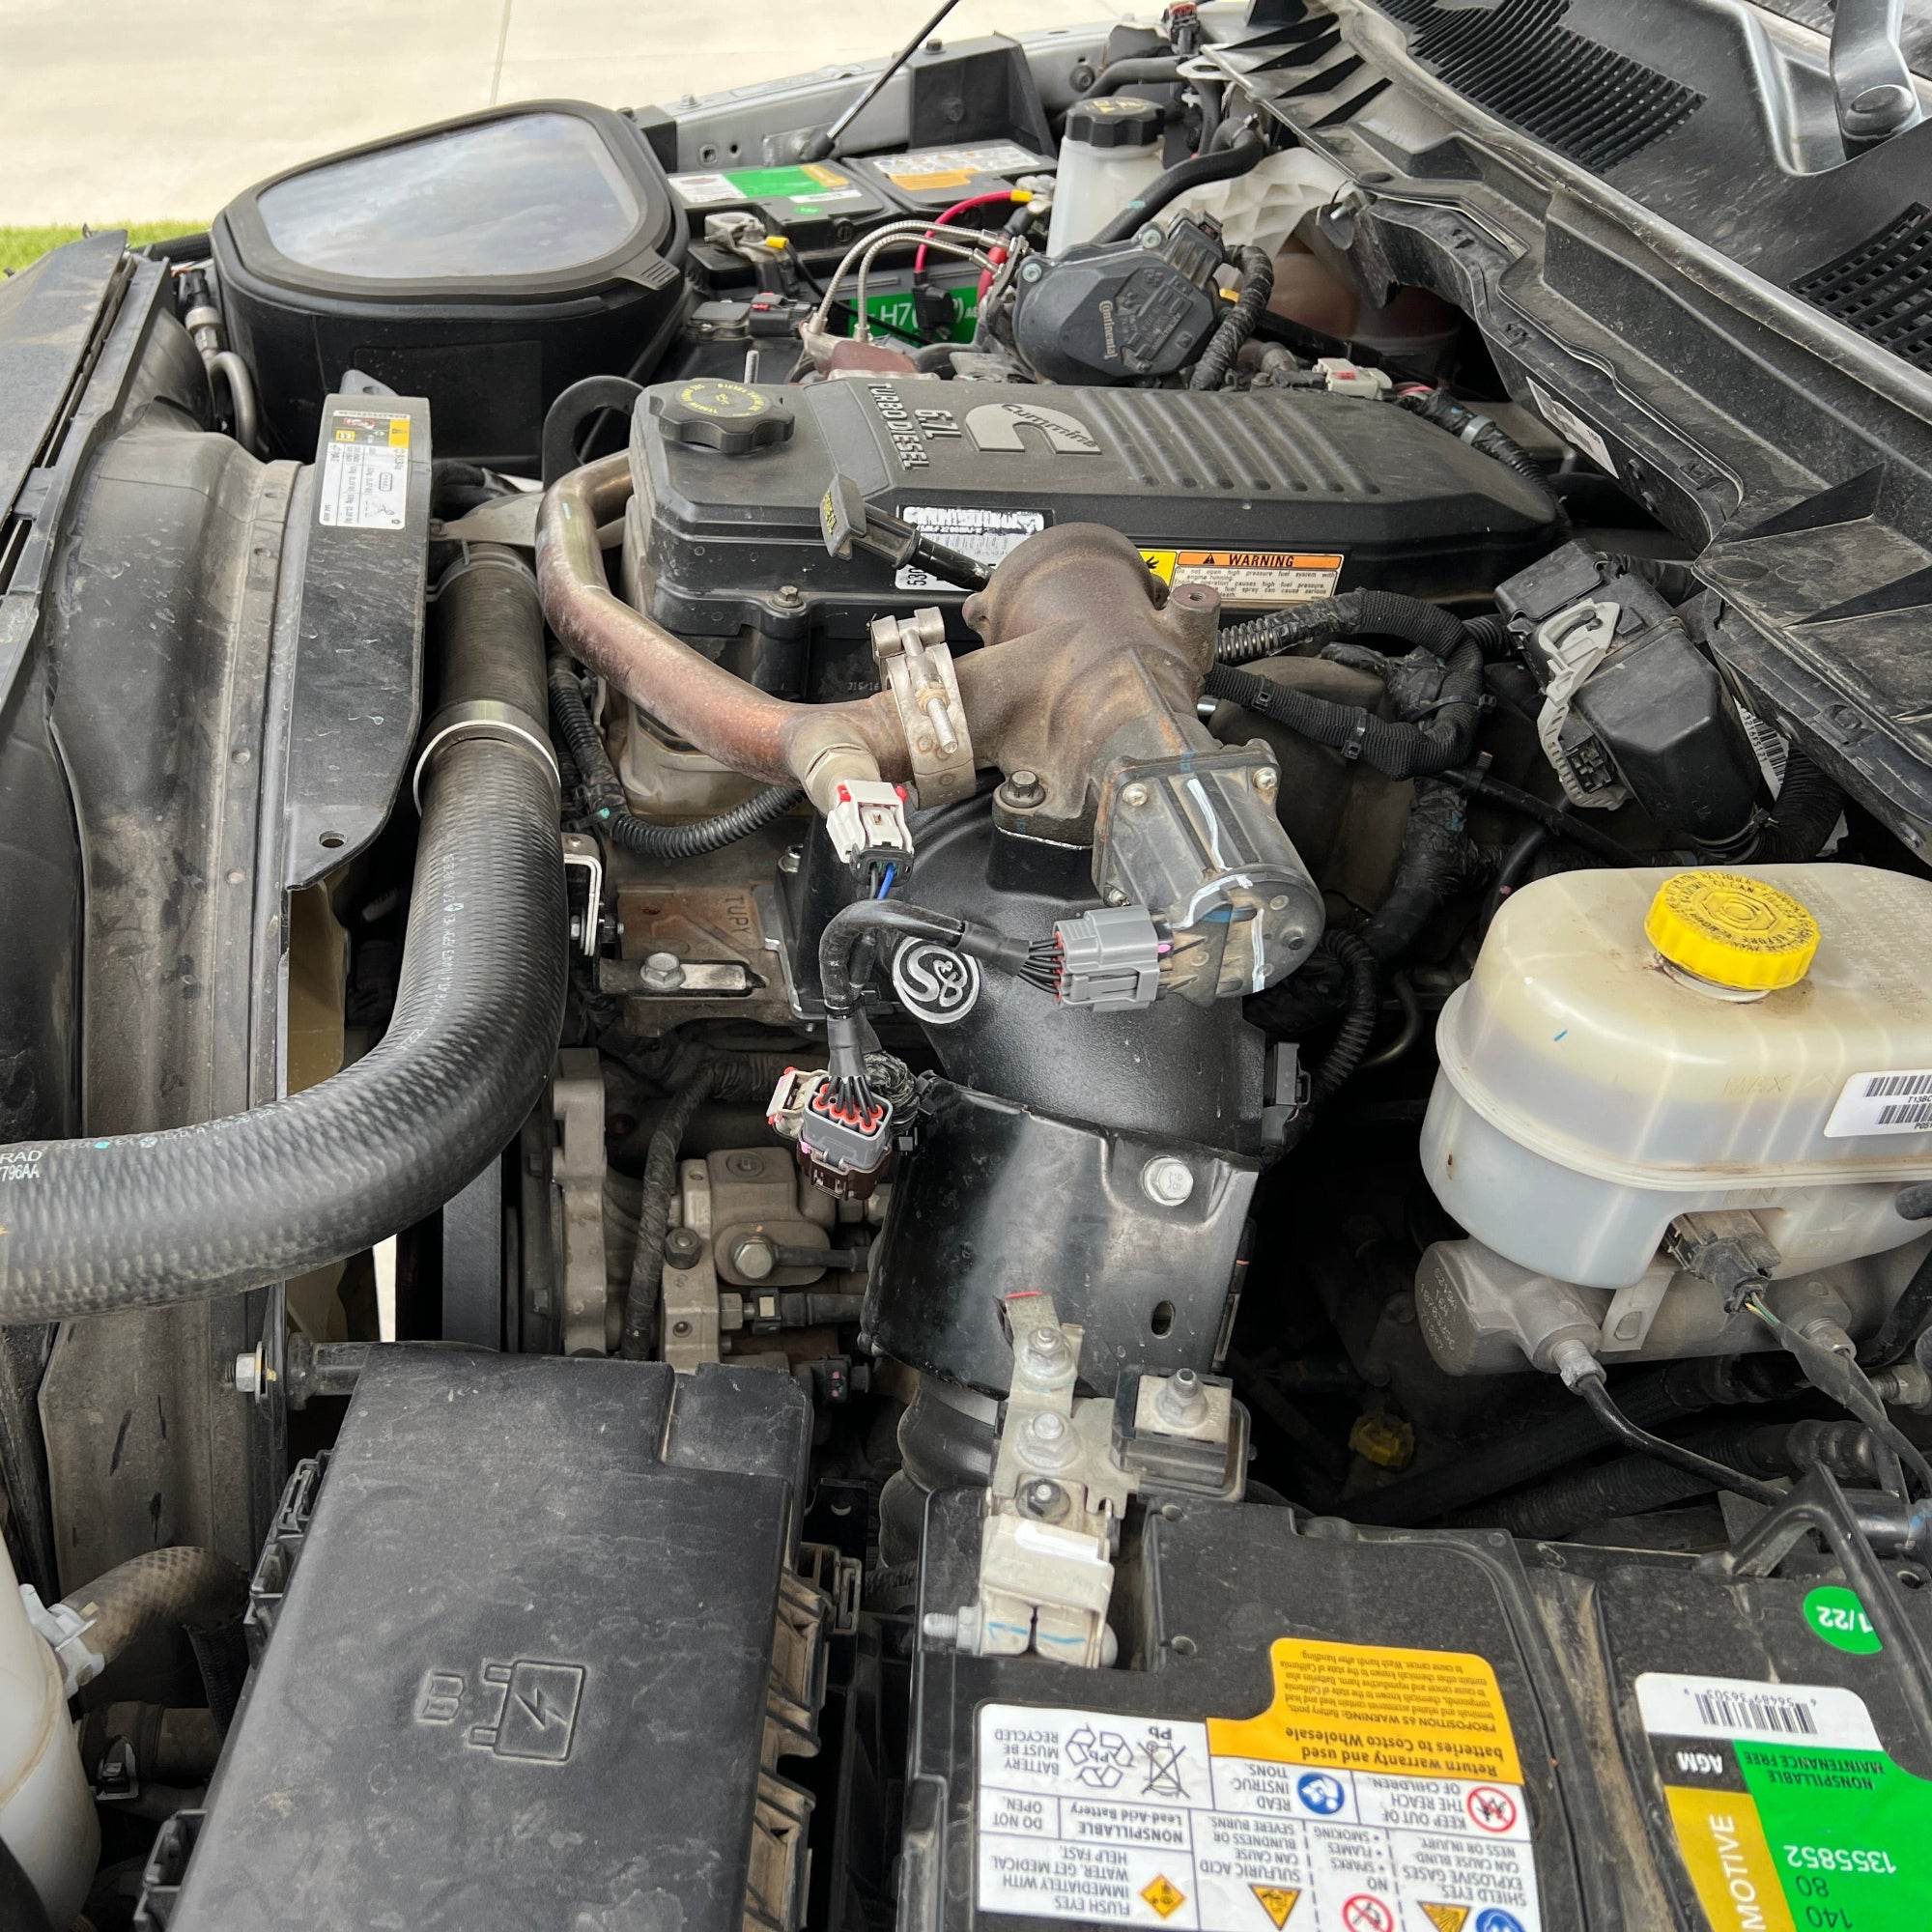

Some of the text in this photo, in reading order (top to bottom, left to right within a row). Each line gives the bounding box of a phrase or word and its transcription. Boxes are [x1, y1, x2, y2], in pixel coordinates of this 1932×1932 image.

[1098, 299, 1119, 360] Continental
[867, 383, 929, 471] TURBO DIESEL
[914, 409, 962, 440] 6.7L
[1002, 403, 1098, 448] Cummins
[1229, 554, 1294, 567] WARNING
[724, 896, 752, 934] TUPY
[0, 1150, 43, 1164] RAD
[1279, 1660, 1316, 1672] California
[1300, 1650, 1463, 1674] to cause cancer. Wash hands after handling.
[1327, 1665, 1345, 1675] state
[1347, 1667, 1359, 1677] the
[1370, 1669, 1396, 1681] known
[1397, 1672, 1435, 1683] chemicals
[1437, 1675, 1457, 1685] other
[1459, 1677, 1488, 1686] contain
[1285, 1671, 1486, 1697] to cause cancer and reproductive harm. Batteries also
[1285, 1683, 1491, 1708] compounds, chemicals known to the state of California
[1285, 1694, 1495, 1719] terminals and related accessories contain lead and lead
[1312, 1706, 1339, 1718] Battery
[1342, 1710, 1400, 1724] WARNING:
[1403, 1716, 1416, 1725] 65
[1418, 1718, 1496, 1733] PROPOSITION
[993, 1727, 1059, 1744] RECYCLED
[1148, 1726, 1172, 1741] Pb
[1003, 1744, 1059, 1759] MUST BE
[1285, 1727, 1504, 1762] batteries to Costco Wholesale
[1089, 1750, 1109, 1764] Pb
[1300, 1747, 1497, 1777] Return warranty and used
[1676, 1751, 1723, 1775] AGM
[1743, 1750, 1884, 1775] MAINTENANCE FREE
[1004, 1758, 1060, 1776] BATTERY
[1244, 1763, 1289, 1778] TIONS.
[1229, 1777, 1290, 1795] INSTRUC-
[1367, 1777, 1461, 1795] OF CHILDREN.
[1767, 1770, 1874, 1790] NONSPILLABLE
[1003, 1797, 1043, 1814] OPEN.
[1256, 1795, 1291, 1811] READ
[1391, 1793, 1464, 1812] THE REACH
[991, 1812, 1043, 1830] DO NOT
[1070, 1803, 1182, 1826] Lead-Acid Battery
[1381, 1808, 1466, 1831] KEEP OUT OF
[1078, 1821, 1182, 1843] NONSPILLABLE
[1208, 1815, 1294, 1835] SEVERE BURNS.
[1313, 1826, 1370, 1842] SMOKING
[1213, 1832, 1296, 1851] BLINDNESS OR
[1327, 1843, 1372, 1858] FLAMES
[1416, 1837, 1517, 1859] NESS OR INJURY.
[1059, 1845, 1127, 1865] HELP FAST.
[1235, 1847, 1298, 1864] CAN CAUSE
[1414, 1852, 1519, 1874] CAN CAUSE BLIND-
[1782, 1844, 1896, 1874] 1355852
[991, 1855, 1128, 1882] WATER. GET MEDICAL
[1200, 1859, 1300, 1882] SULFURIC ACID
[1329, 1857, 1375, 1873] SPARKS
[1002, 1874, 1128, 1897] IMMEDIATELY WITH
[1366, 1877, 1387, 1891] NO
[1402, 1865, 1522, 1890] EXPLOSIVE GASES
[1795, 1874, 1830, 1897] 80
[1053, 1896, 1130, 1917] FLUSH EYES
[1477, 1889, 1526, 1907] SHIELD
[1805, 1905, 1853, 1929] 140
